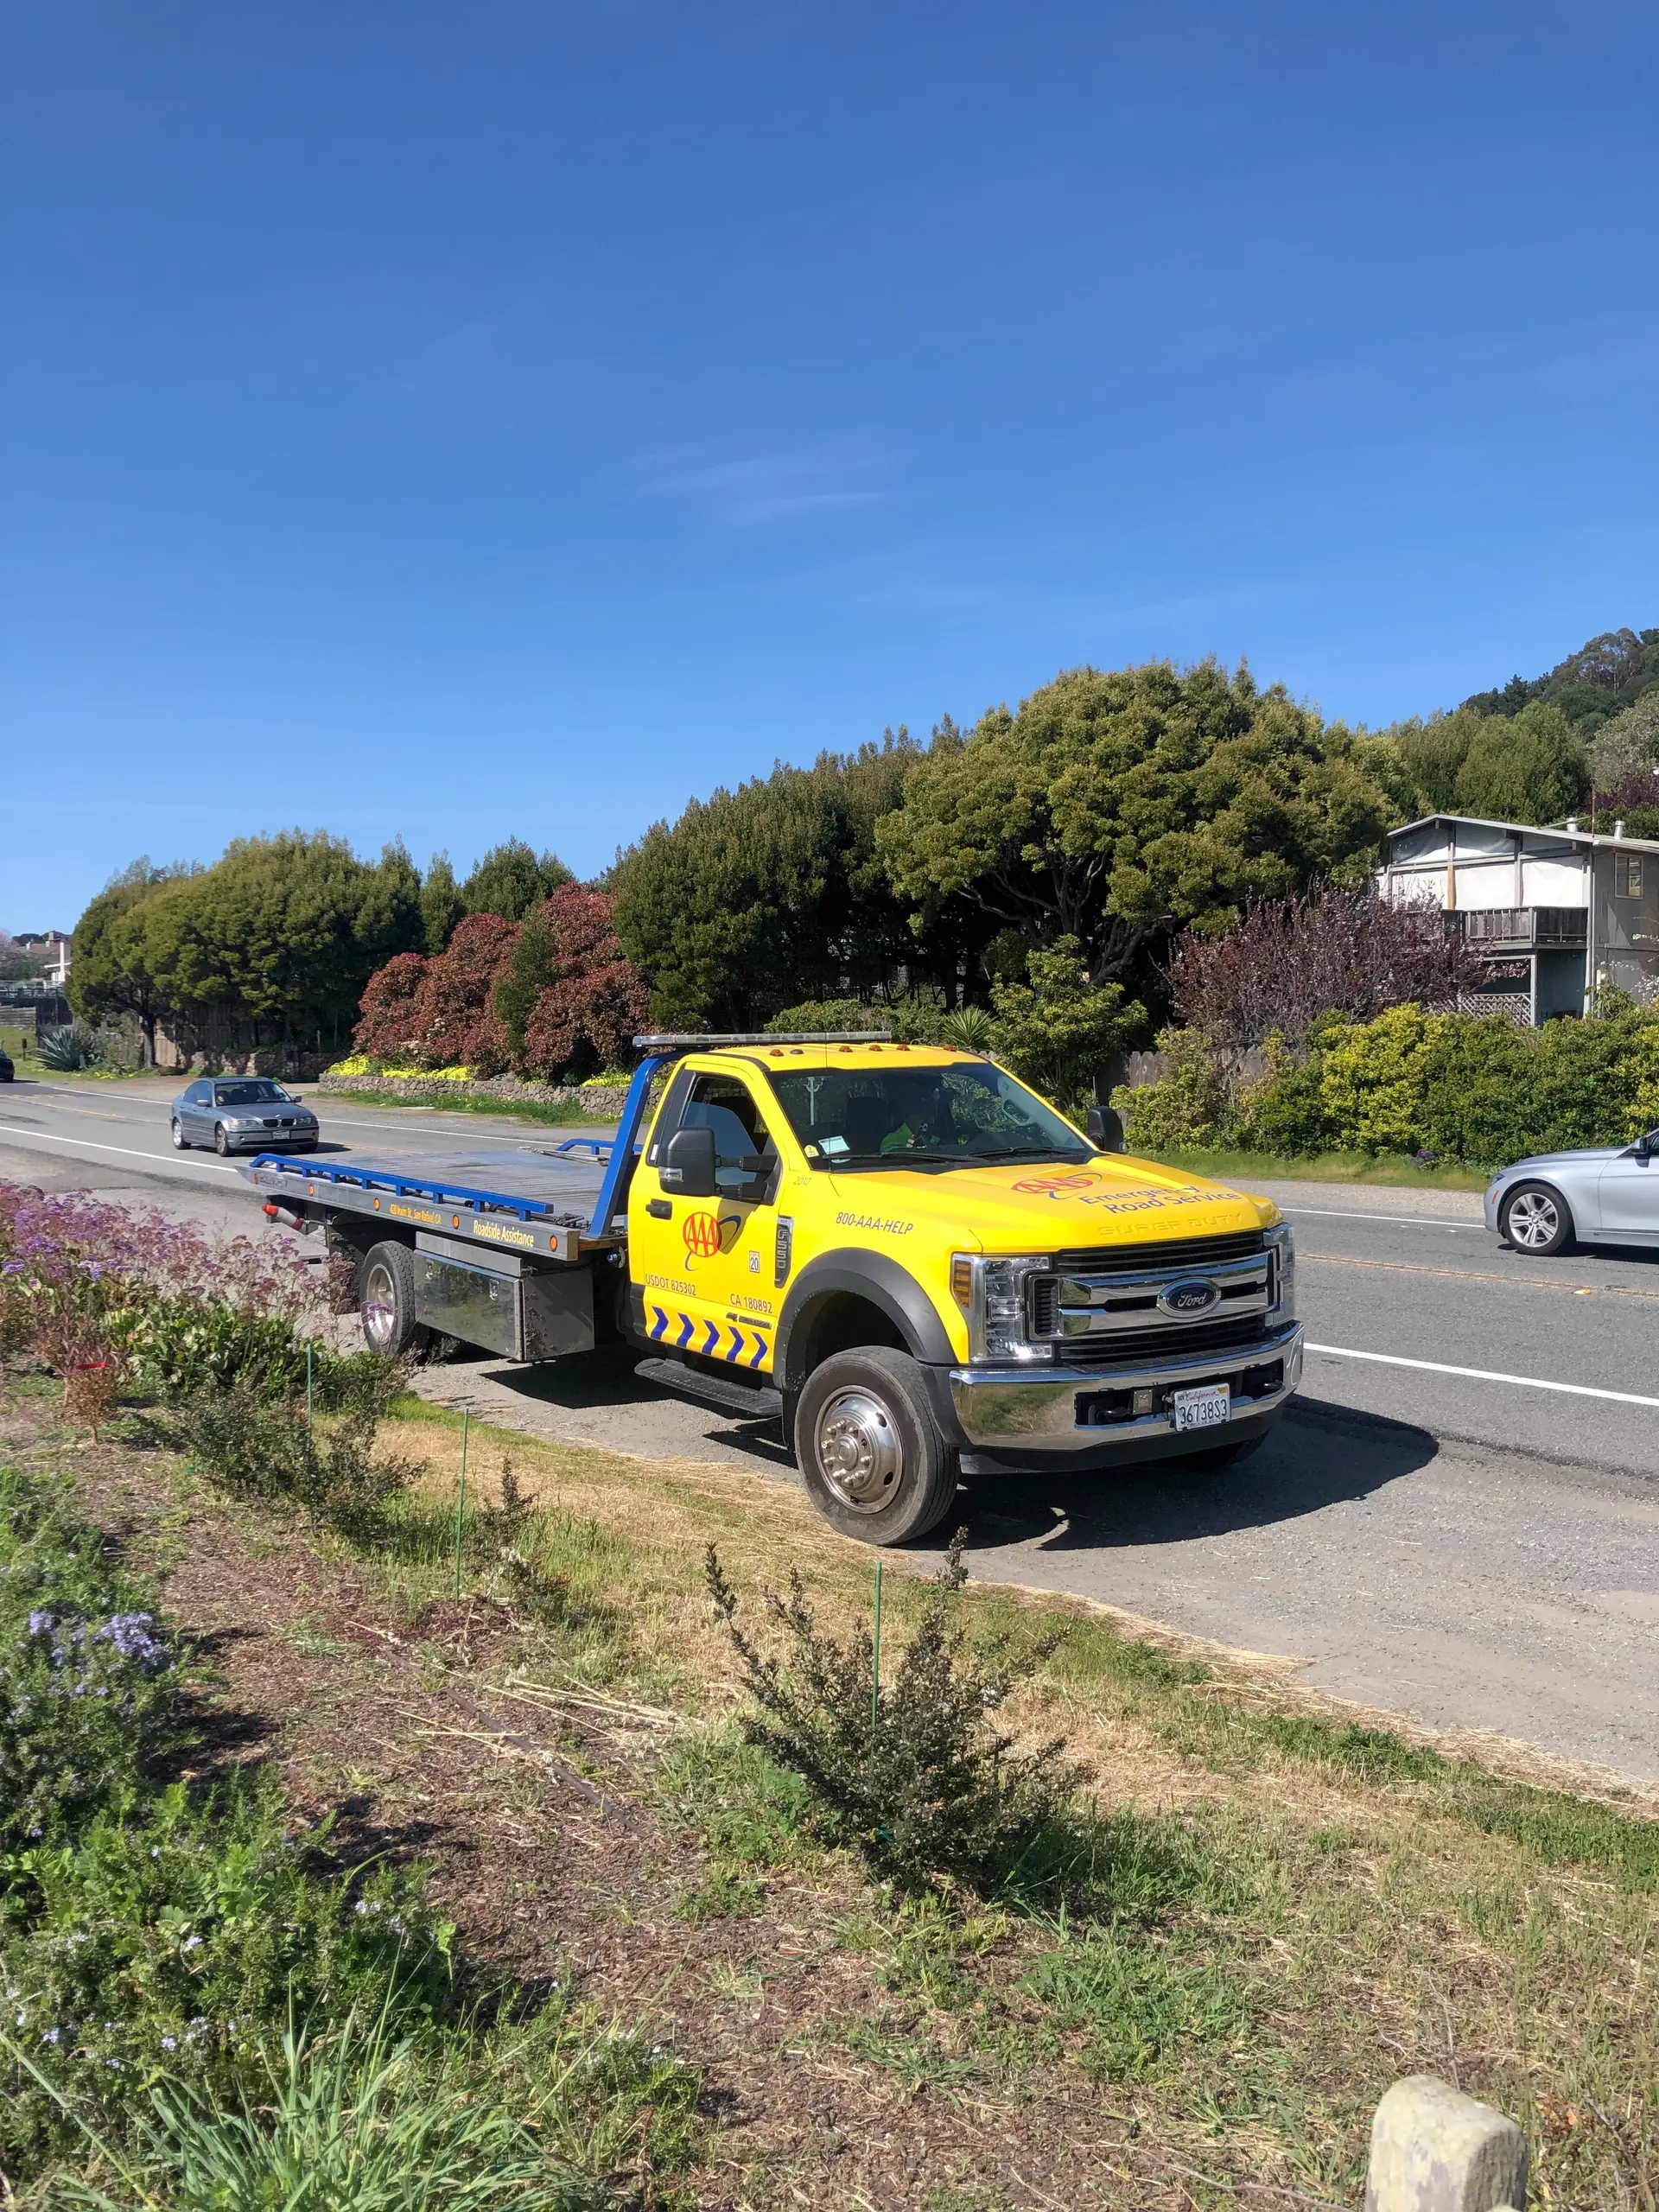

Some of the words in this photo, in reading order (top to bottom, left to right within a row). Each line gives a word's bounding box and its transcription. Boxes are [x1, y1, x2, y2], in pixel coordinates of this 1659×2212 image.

[793, 1176, 811, 1186] 2010
[1012, 1177, 1094, 1194] AAA
[1103, 1198, 1166, 1214] Road
[1164, 1192, 1243, 1205] Service
[474, 1220, 501, 1240] Roadside
[501, 1226, 535, 1248] Assistance
[683, 1211, 722, 1258] AAA
[836, 1211, 913, 1236] 800-AAA-HELP
[1098, 1220, 1185, 1236] SUPER
[1189, 1213, 1243, 1228] DUTY
[750, 1256, 759, 1271] 20
[645, 1274, 670, 1288] USDOT
[671, 1280, 696, 1296] 825302
[730, 1294, 742, 1306] CA
[744, 1297, 772, 1314] 180892
[1177, 1291, 1207, 1307] Ford
[1185, 1391, 1219, 1402] California
[1179, 1399, 1227, 1424] 36738S3
